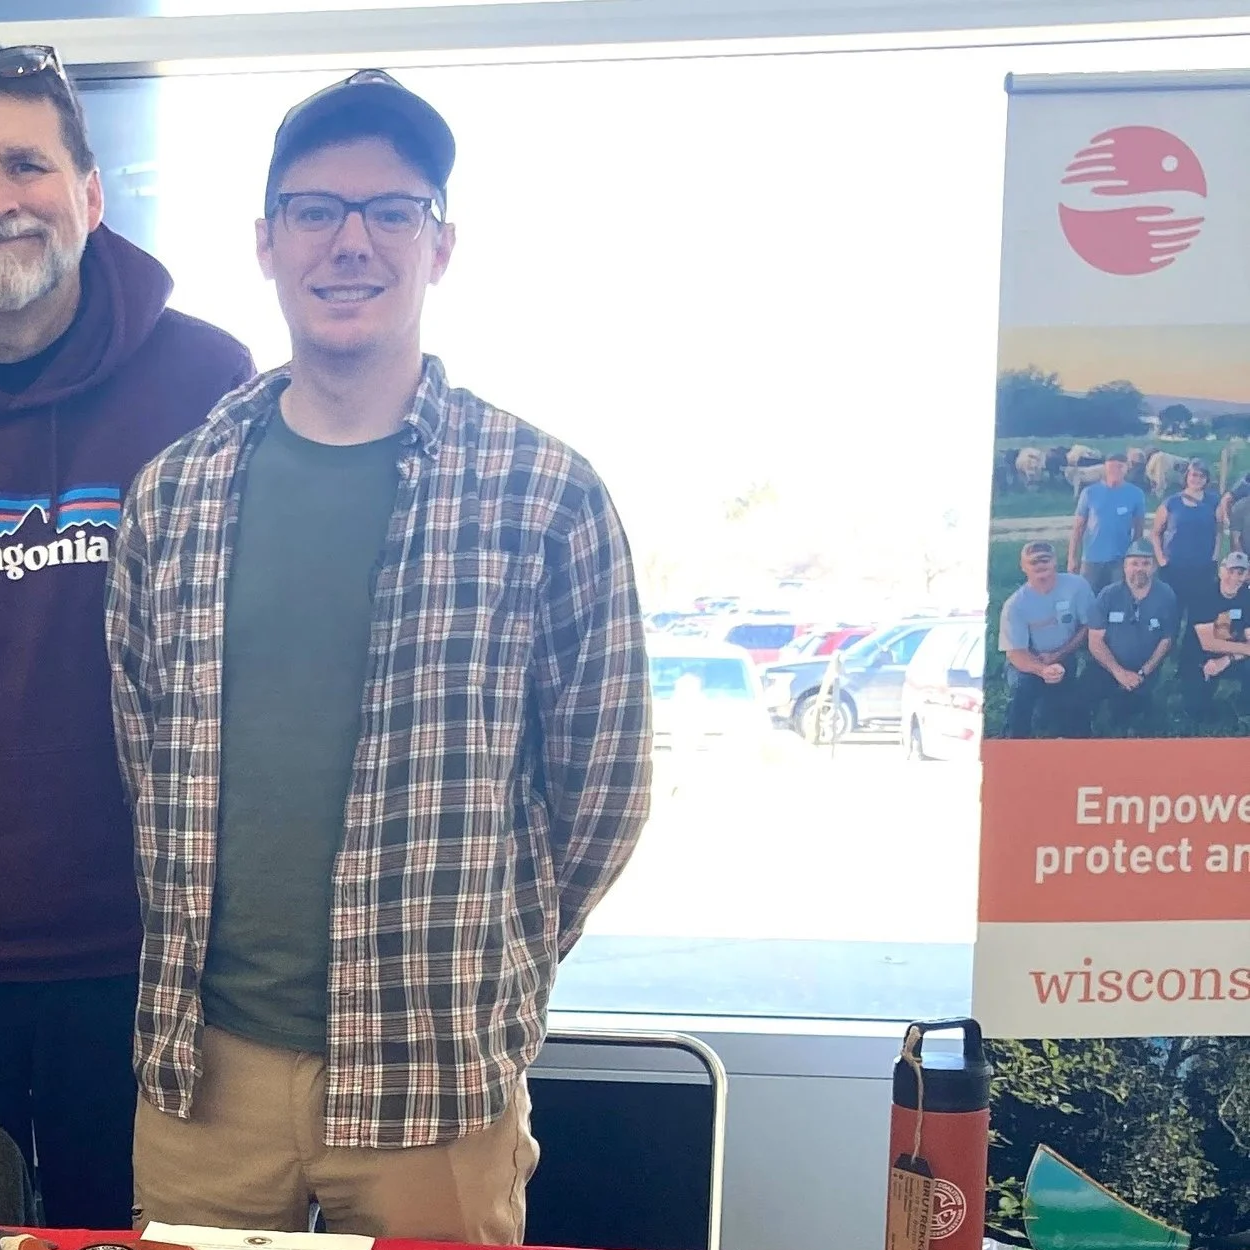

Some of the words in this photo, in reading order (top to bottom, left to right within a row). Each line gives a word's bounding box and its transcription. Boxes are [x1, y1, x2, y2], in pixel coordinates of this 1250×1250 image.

[1035, 838, 1192, 884] protect
[1205, 843, 1250, 873] an
[1029, 957, 1250, 1004] wiscons
